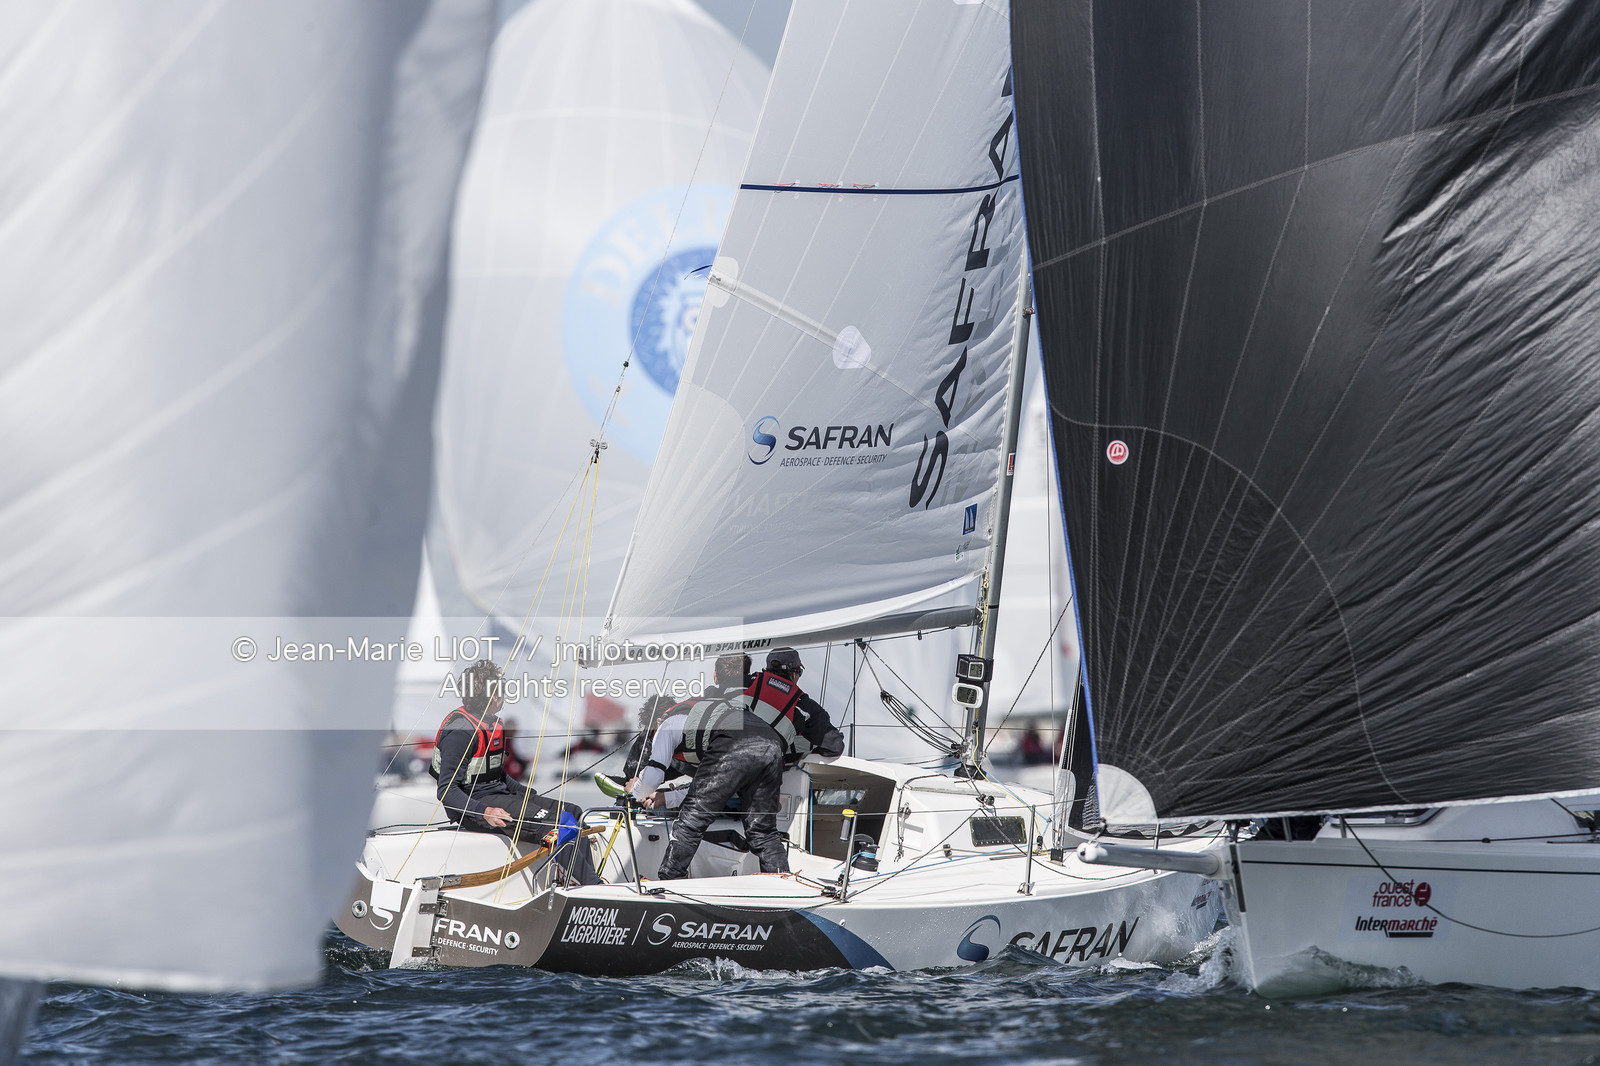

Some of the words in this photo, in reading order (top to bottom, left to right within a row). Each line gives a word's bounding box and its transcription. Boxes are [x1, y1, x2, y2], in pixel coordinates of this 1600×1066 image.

[908, 65, 1015, 510] SAFRA
[784, 423, 894, 451] SAFRAN
[780, 456, 821, 467] AEROSPACE
[823, 455, 855, 466] DEFENCE
[856, 453, 888, 465] SECURITY
[1379, 879, 1415, 895] ouest
[1372, 891, 1413, 907] france
[567, 906, 619, 926] MORGAN
[1355, 916, 1438, 936] Intermarché
[434, 917, 502, 945] FRAN
[677, 921, 773, 941] SAFRAN
[437, 937, 467, 950] DEFENCE
[468, 943, 499, 956] SECURITY
[672, 941, 706, 950] AEROSPACE
[709, 943, 735, 951] DEFENCE
[736, 944, 764, 952] SECURITY
